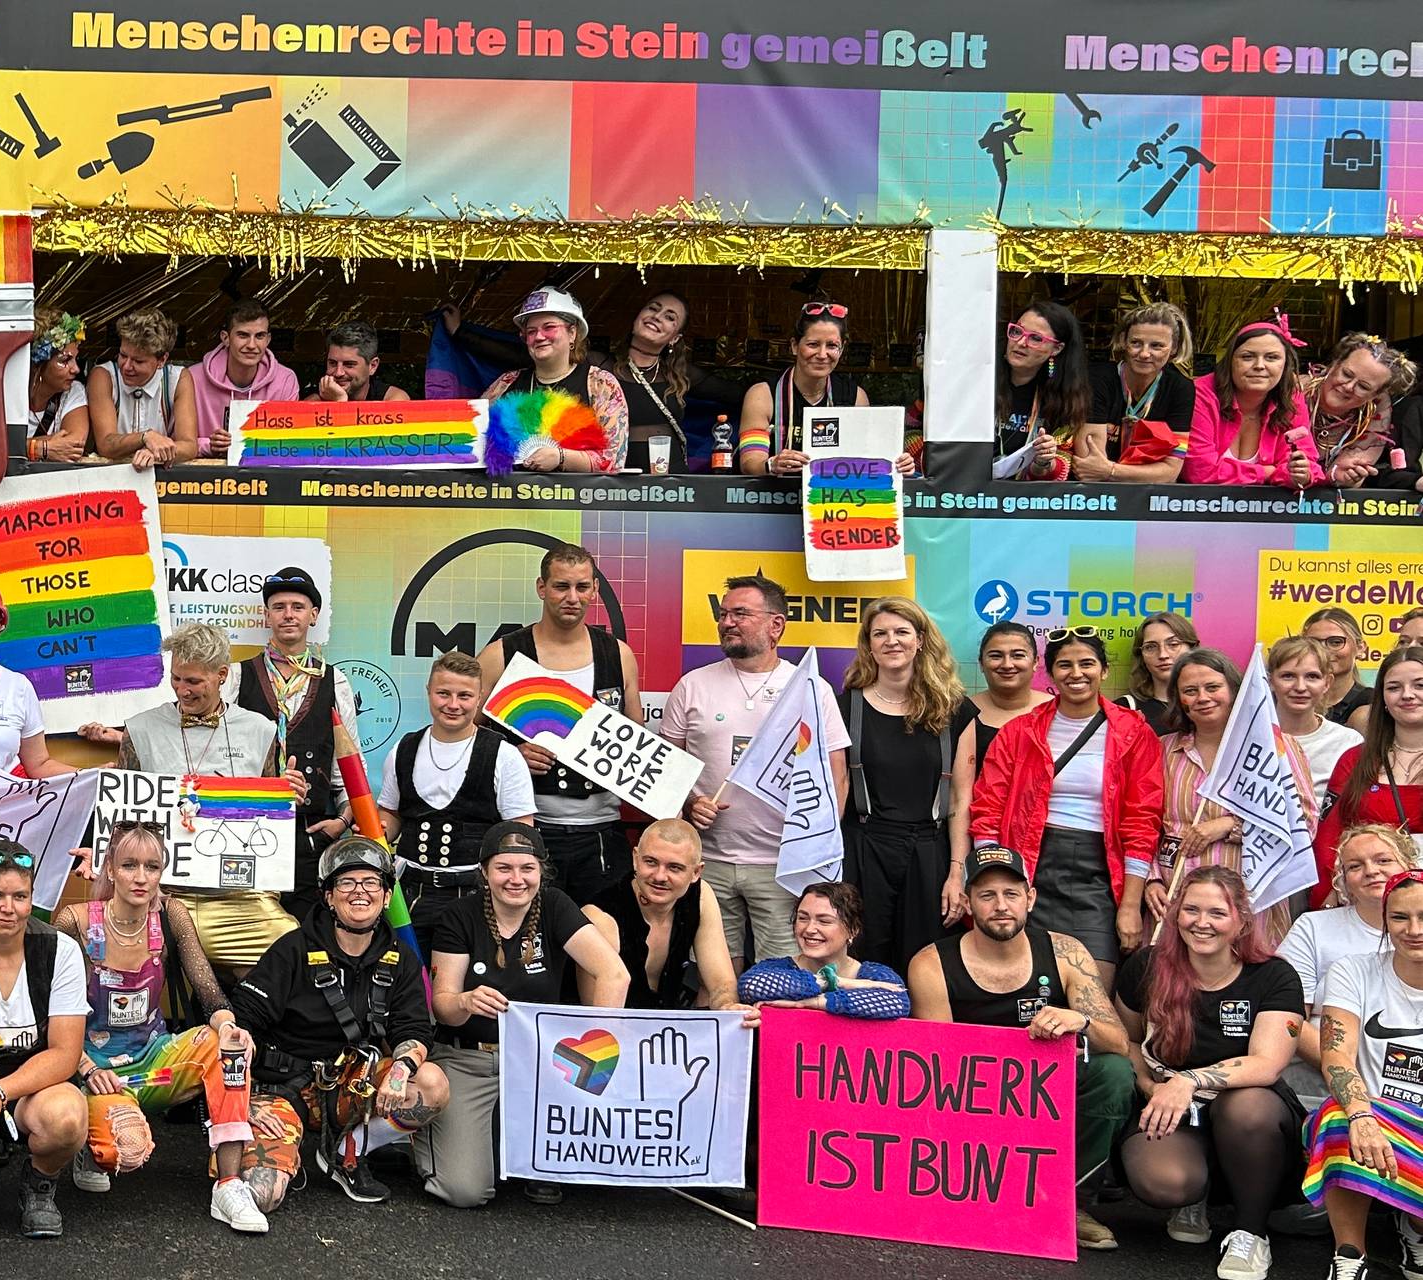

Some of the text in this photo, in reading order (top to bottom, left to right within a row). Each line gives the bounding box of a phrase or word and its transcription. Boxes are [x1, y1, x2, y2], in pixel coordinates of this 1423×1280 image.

[72, 12, 988, 70] Menschenrechte in Stein gemeißelt
[255, 407, 403, 428] Hass ist krass
[312, 440, 332, 457] ist
[344, 434, 456, 457] KRASSER
[819, 461, 879, 480] LOVE
[301, 479, 696, 505] Menschenrechte in Stein gemeißelt
[821, 487, 868, 508] HAS
[916, 492, 935, 508] in
[941, 492, 998, 510] Stein
[1002, 493, 1118, 514] gemeißelt
[823, 508, 848, 524] NO
[1149, 495, 1419, 518] Menschenrechte in Stein
[35, 536, 83, 561] FOR
[820, 526, 899, 549] GENDER
[1269, 557, 1293, 572] Du
[1298, 558, 1351, 573] kannst
[1357, 560, 1393, 574] alles
[21, 570, 92, 595] THOSE
[46, 605, 95, 628] WHO
[37, 635, 97, 660] CAN'T
[351, 666, 393, 698] FREIHEIT
[597, 713, 672, 765] LOVE
[589, 731, 662, 785] WORK
[574, 748, 651, 802] LOVE
[99, 772, 176, 807] RIDE
[111, 1009, 139, 1019] BUNTES
[794, 1042, 1060, 1121] HANDWERK
[1384, 1064, 1417, 1078] BUNTES
[547, 1104, 673, 1140] BUNTES
[545, 1140, 690, 1167] HANDWERK
[807, 1129, 1058, 1208] IST BUNT
